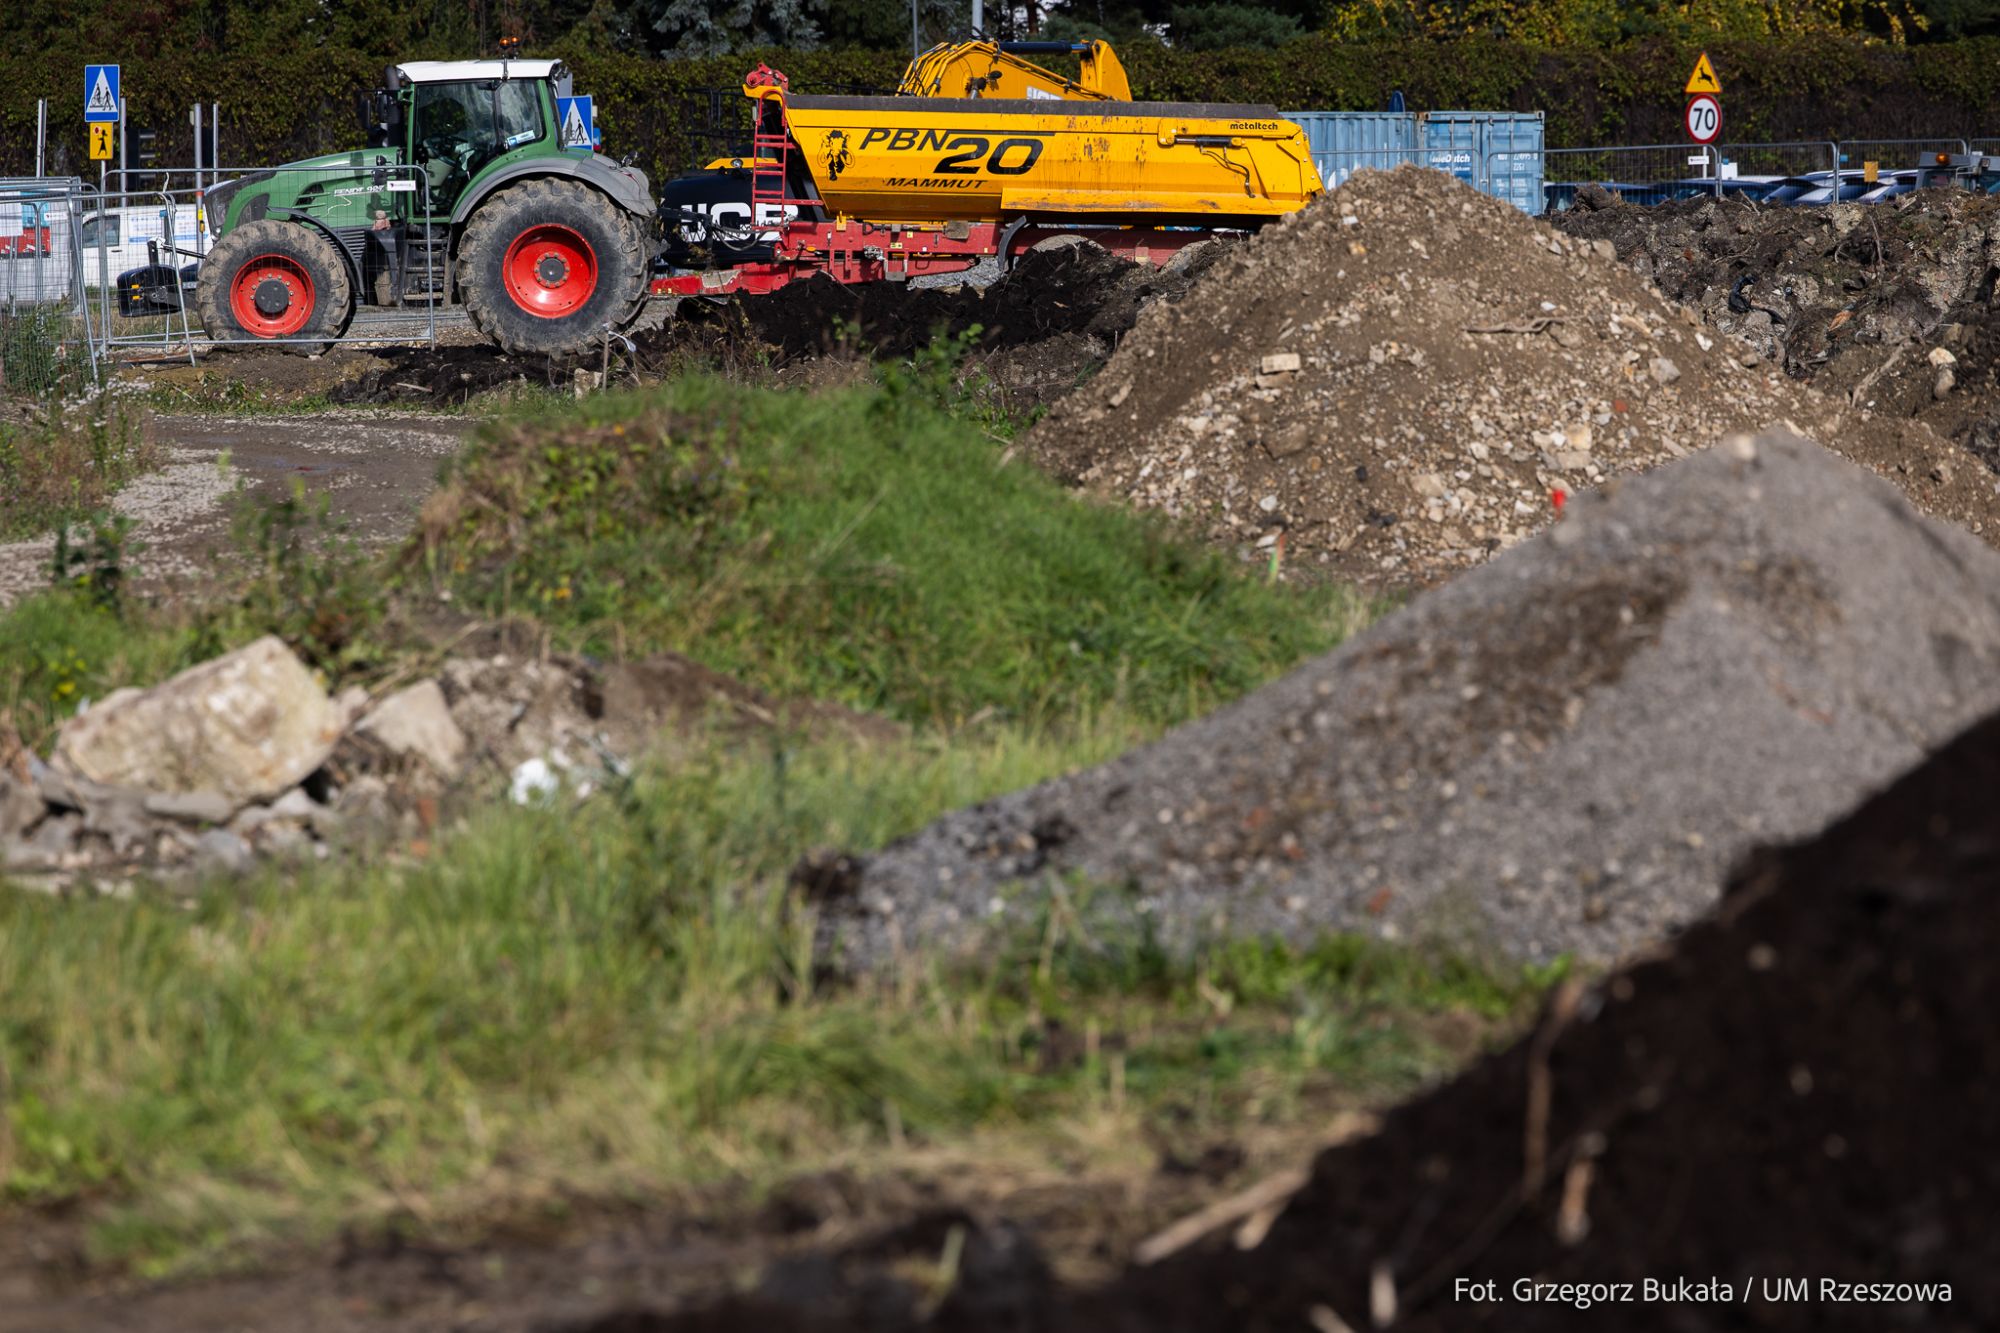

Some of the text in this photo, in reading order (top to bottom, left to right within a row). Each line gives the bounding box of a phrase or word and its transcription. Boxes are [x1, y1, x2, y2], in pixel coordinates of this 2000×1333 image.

[1230, 122, 1278, 130] metaltech
[1693, 107, 1716, 131] 70
[859, 128, 951, 151] PBN
[933, 137, 1044, 175] 20
[885, 177, 988, 189] MAMMUT
